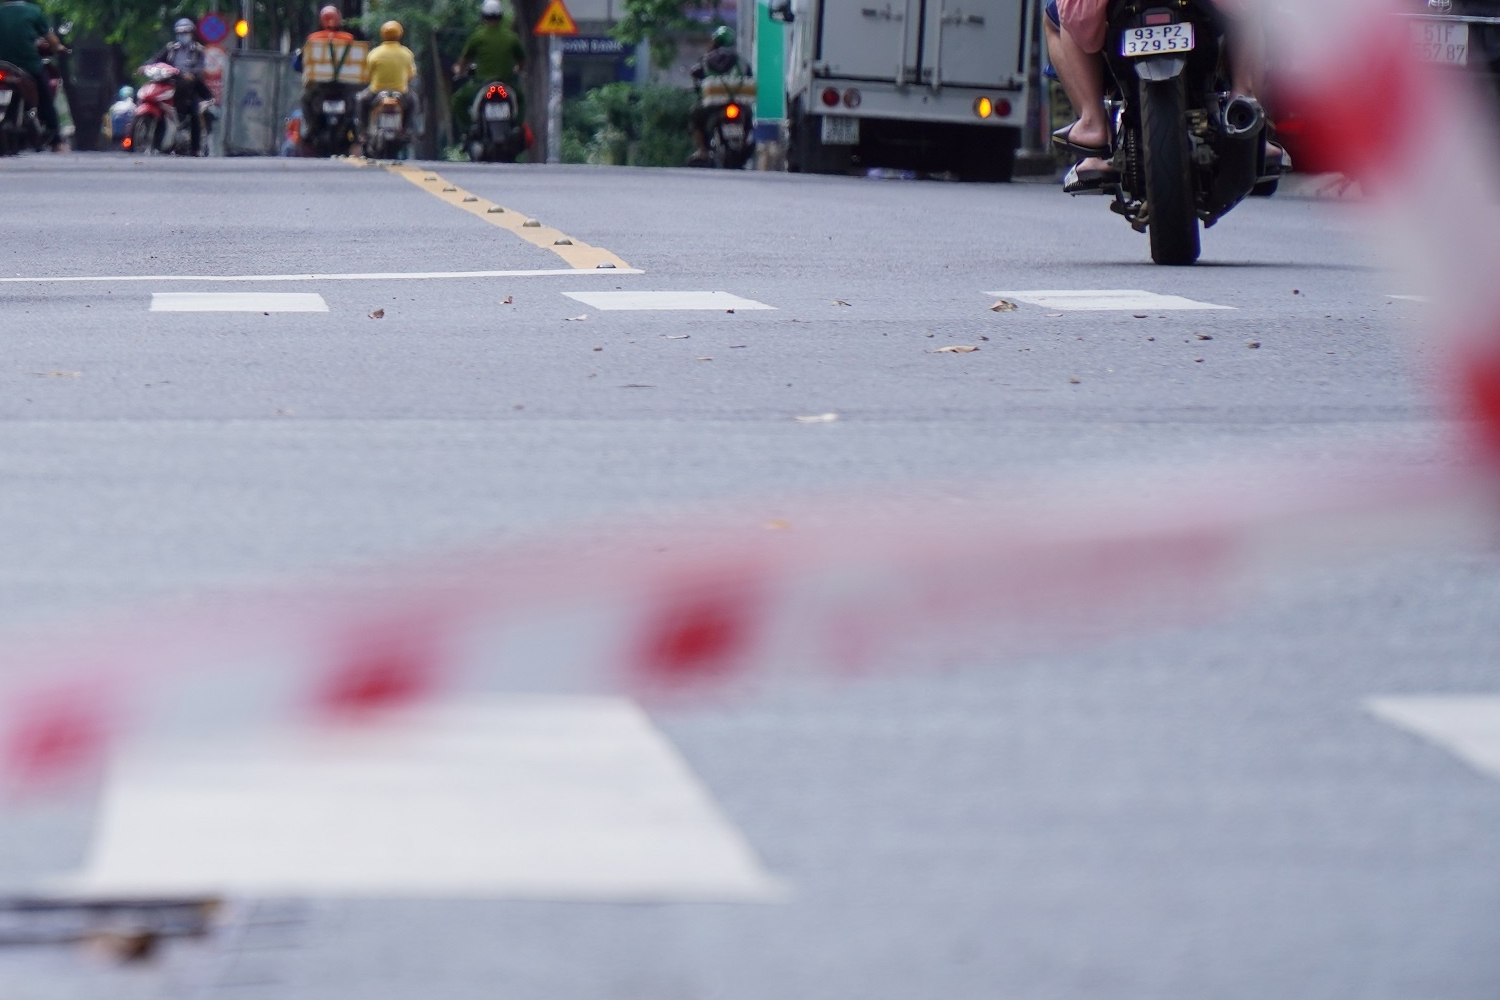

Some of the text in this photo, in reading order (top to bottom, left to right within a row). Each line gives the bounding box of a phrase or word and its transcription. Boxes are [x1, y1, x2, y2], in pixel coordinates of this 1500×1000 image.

[1134, 25, 1182, 40] 93-P2
[1424, 24, 1455, 42] 51F
[1128, 37, 1189, 53] 329.53
